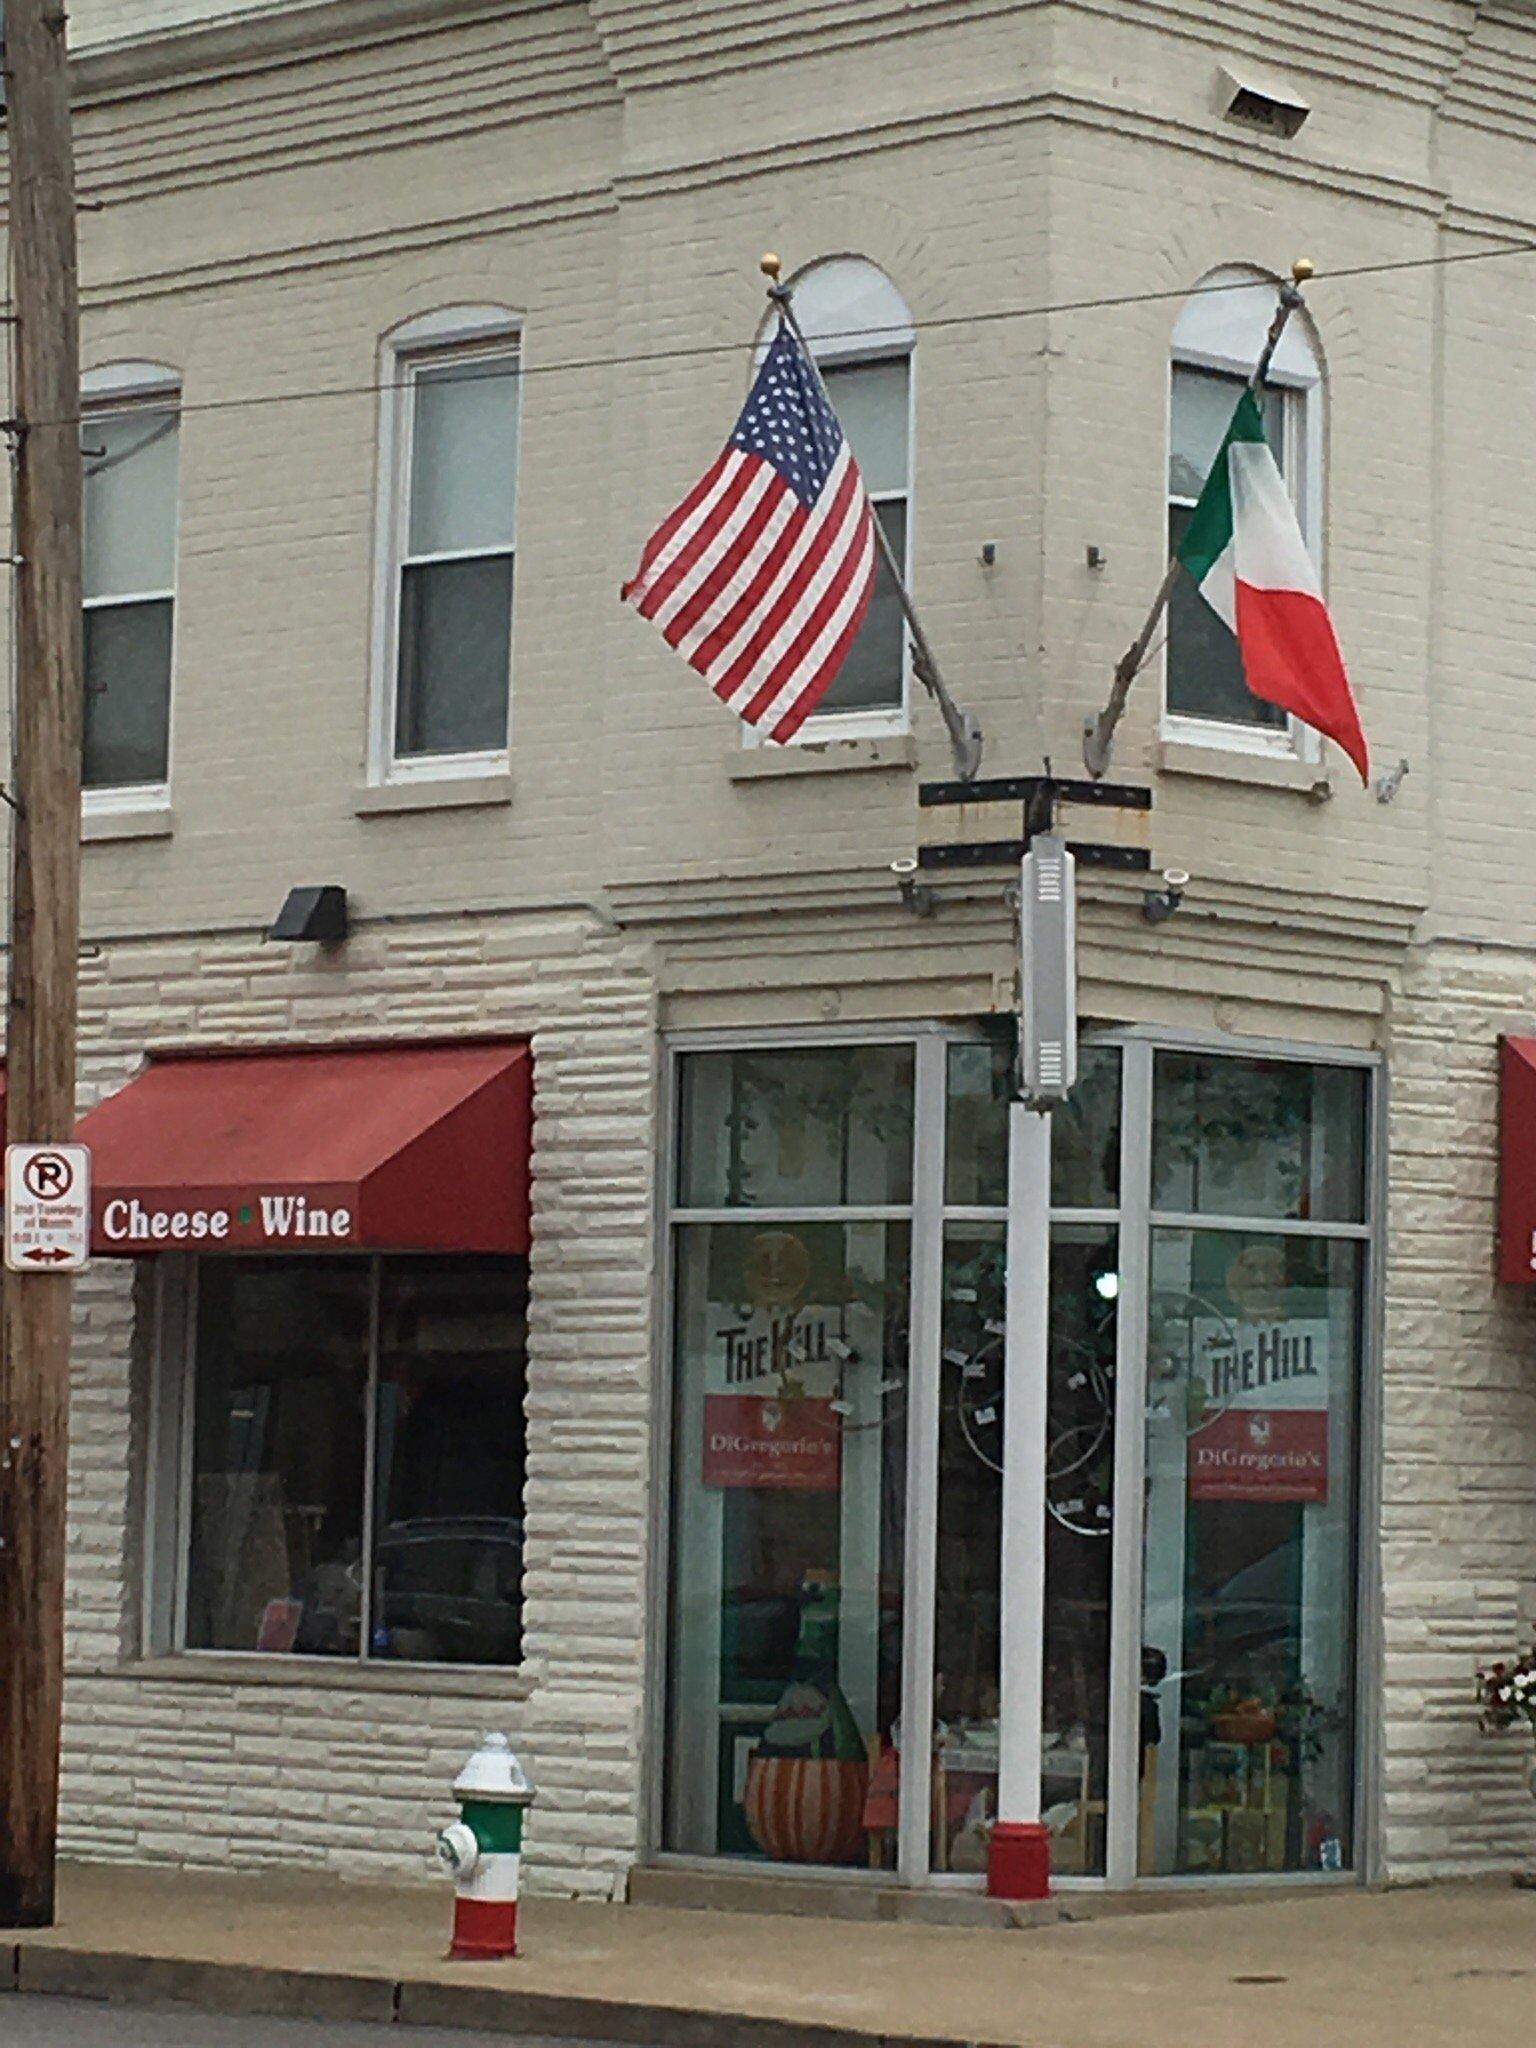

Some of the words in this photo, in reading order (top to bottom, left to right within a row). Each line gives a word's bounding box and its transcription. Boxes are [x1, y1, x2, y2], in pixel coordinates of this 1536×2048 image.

[103, 1199, 229, 1239] Cheese
[260, 1196, 350, 1237] Wine
[1257, 1328, 1318, 1386] HILL
